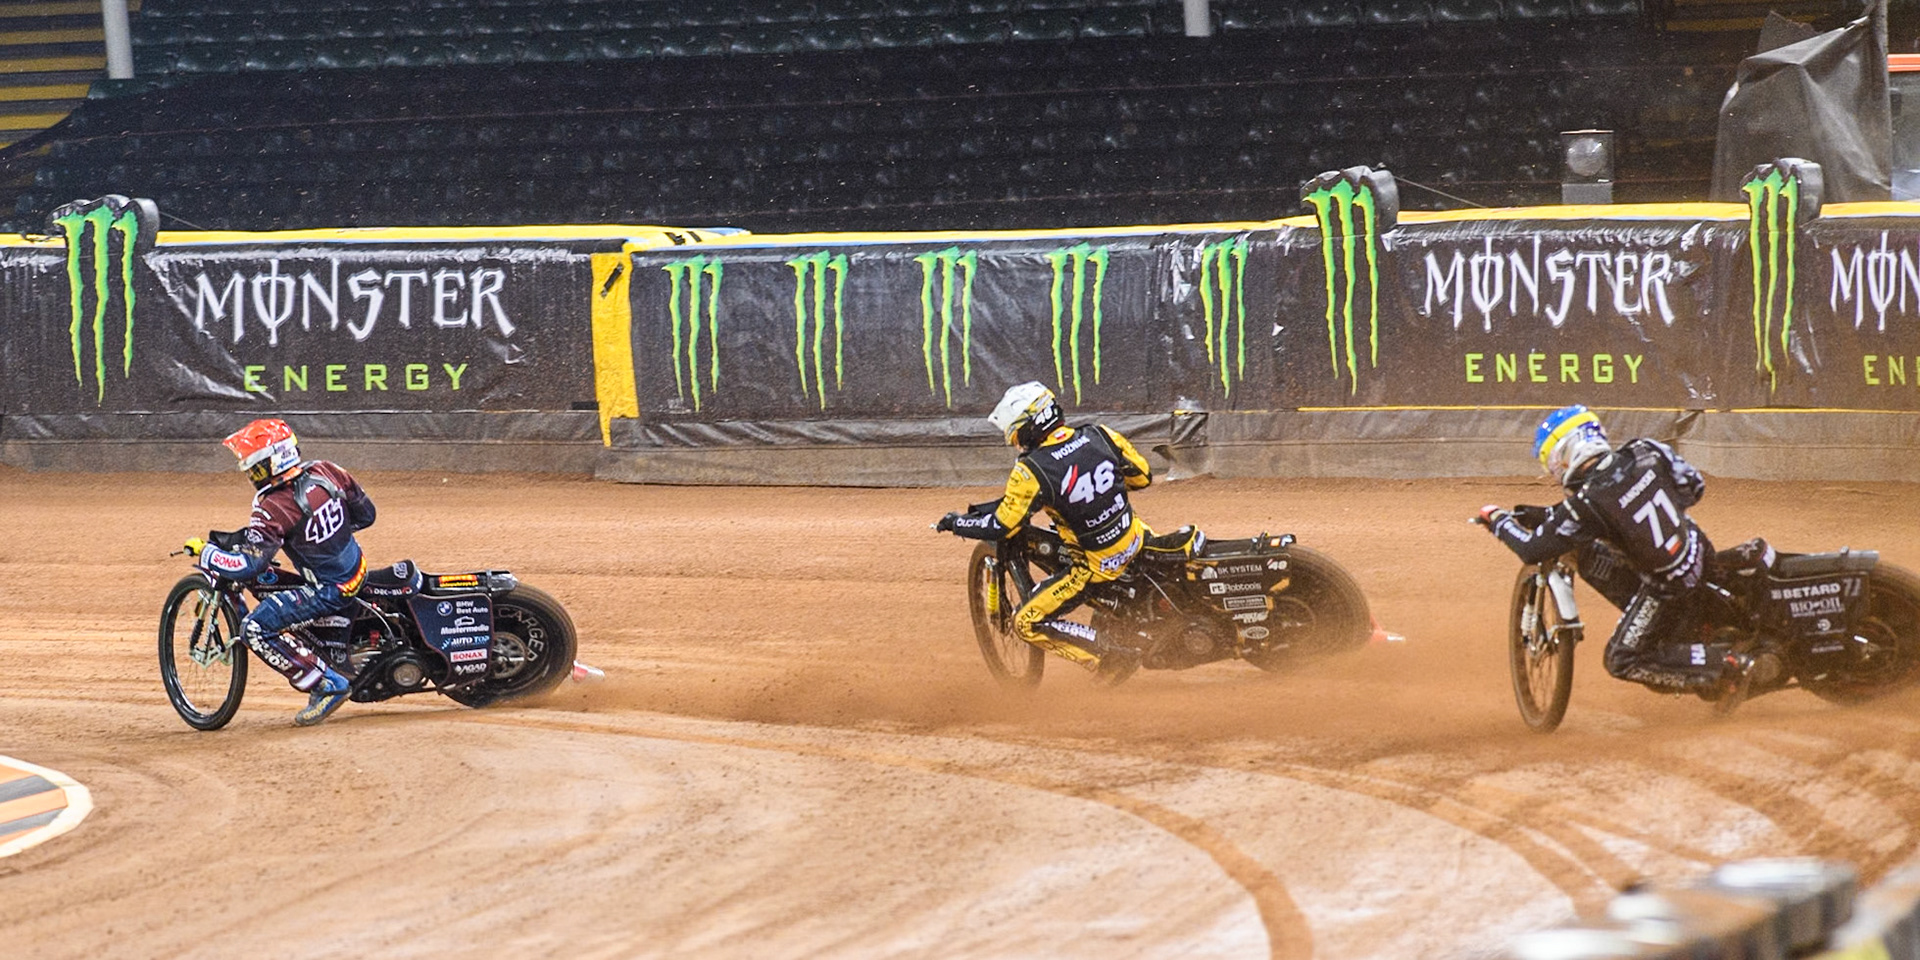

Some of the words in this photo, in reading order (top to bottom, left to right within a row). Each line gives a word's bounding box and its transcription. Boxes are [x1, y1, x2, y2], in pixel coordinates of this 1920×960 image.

[244, 363, 468, 393] ENERGY
[1466, 353, 1644, 384] ENERGY
[1864, 355, 1920, 385] EN
[1069, 460, 1115, 504] 46
[305, 498, 344, 544] 415
[1632, 488, 1681, 549] 71
[1783, 583, 1841, 599] BETARD
[451, 637, 473, 645] AUTO
[453, 652, 483, 660] SONAX
